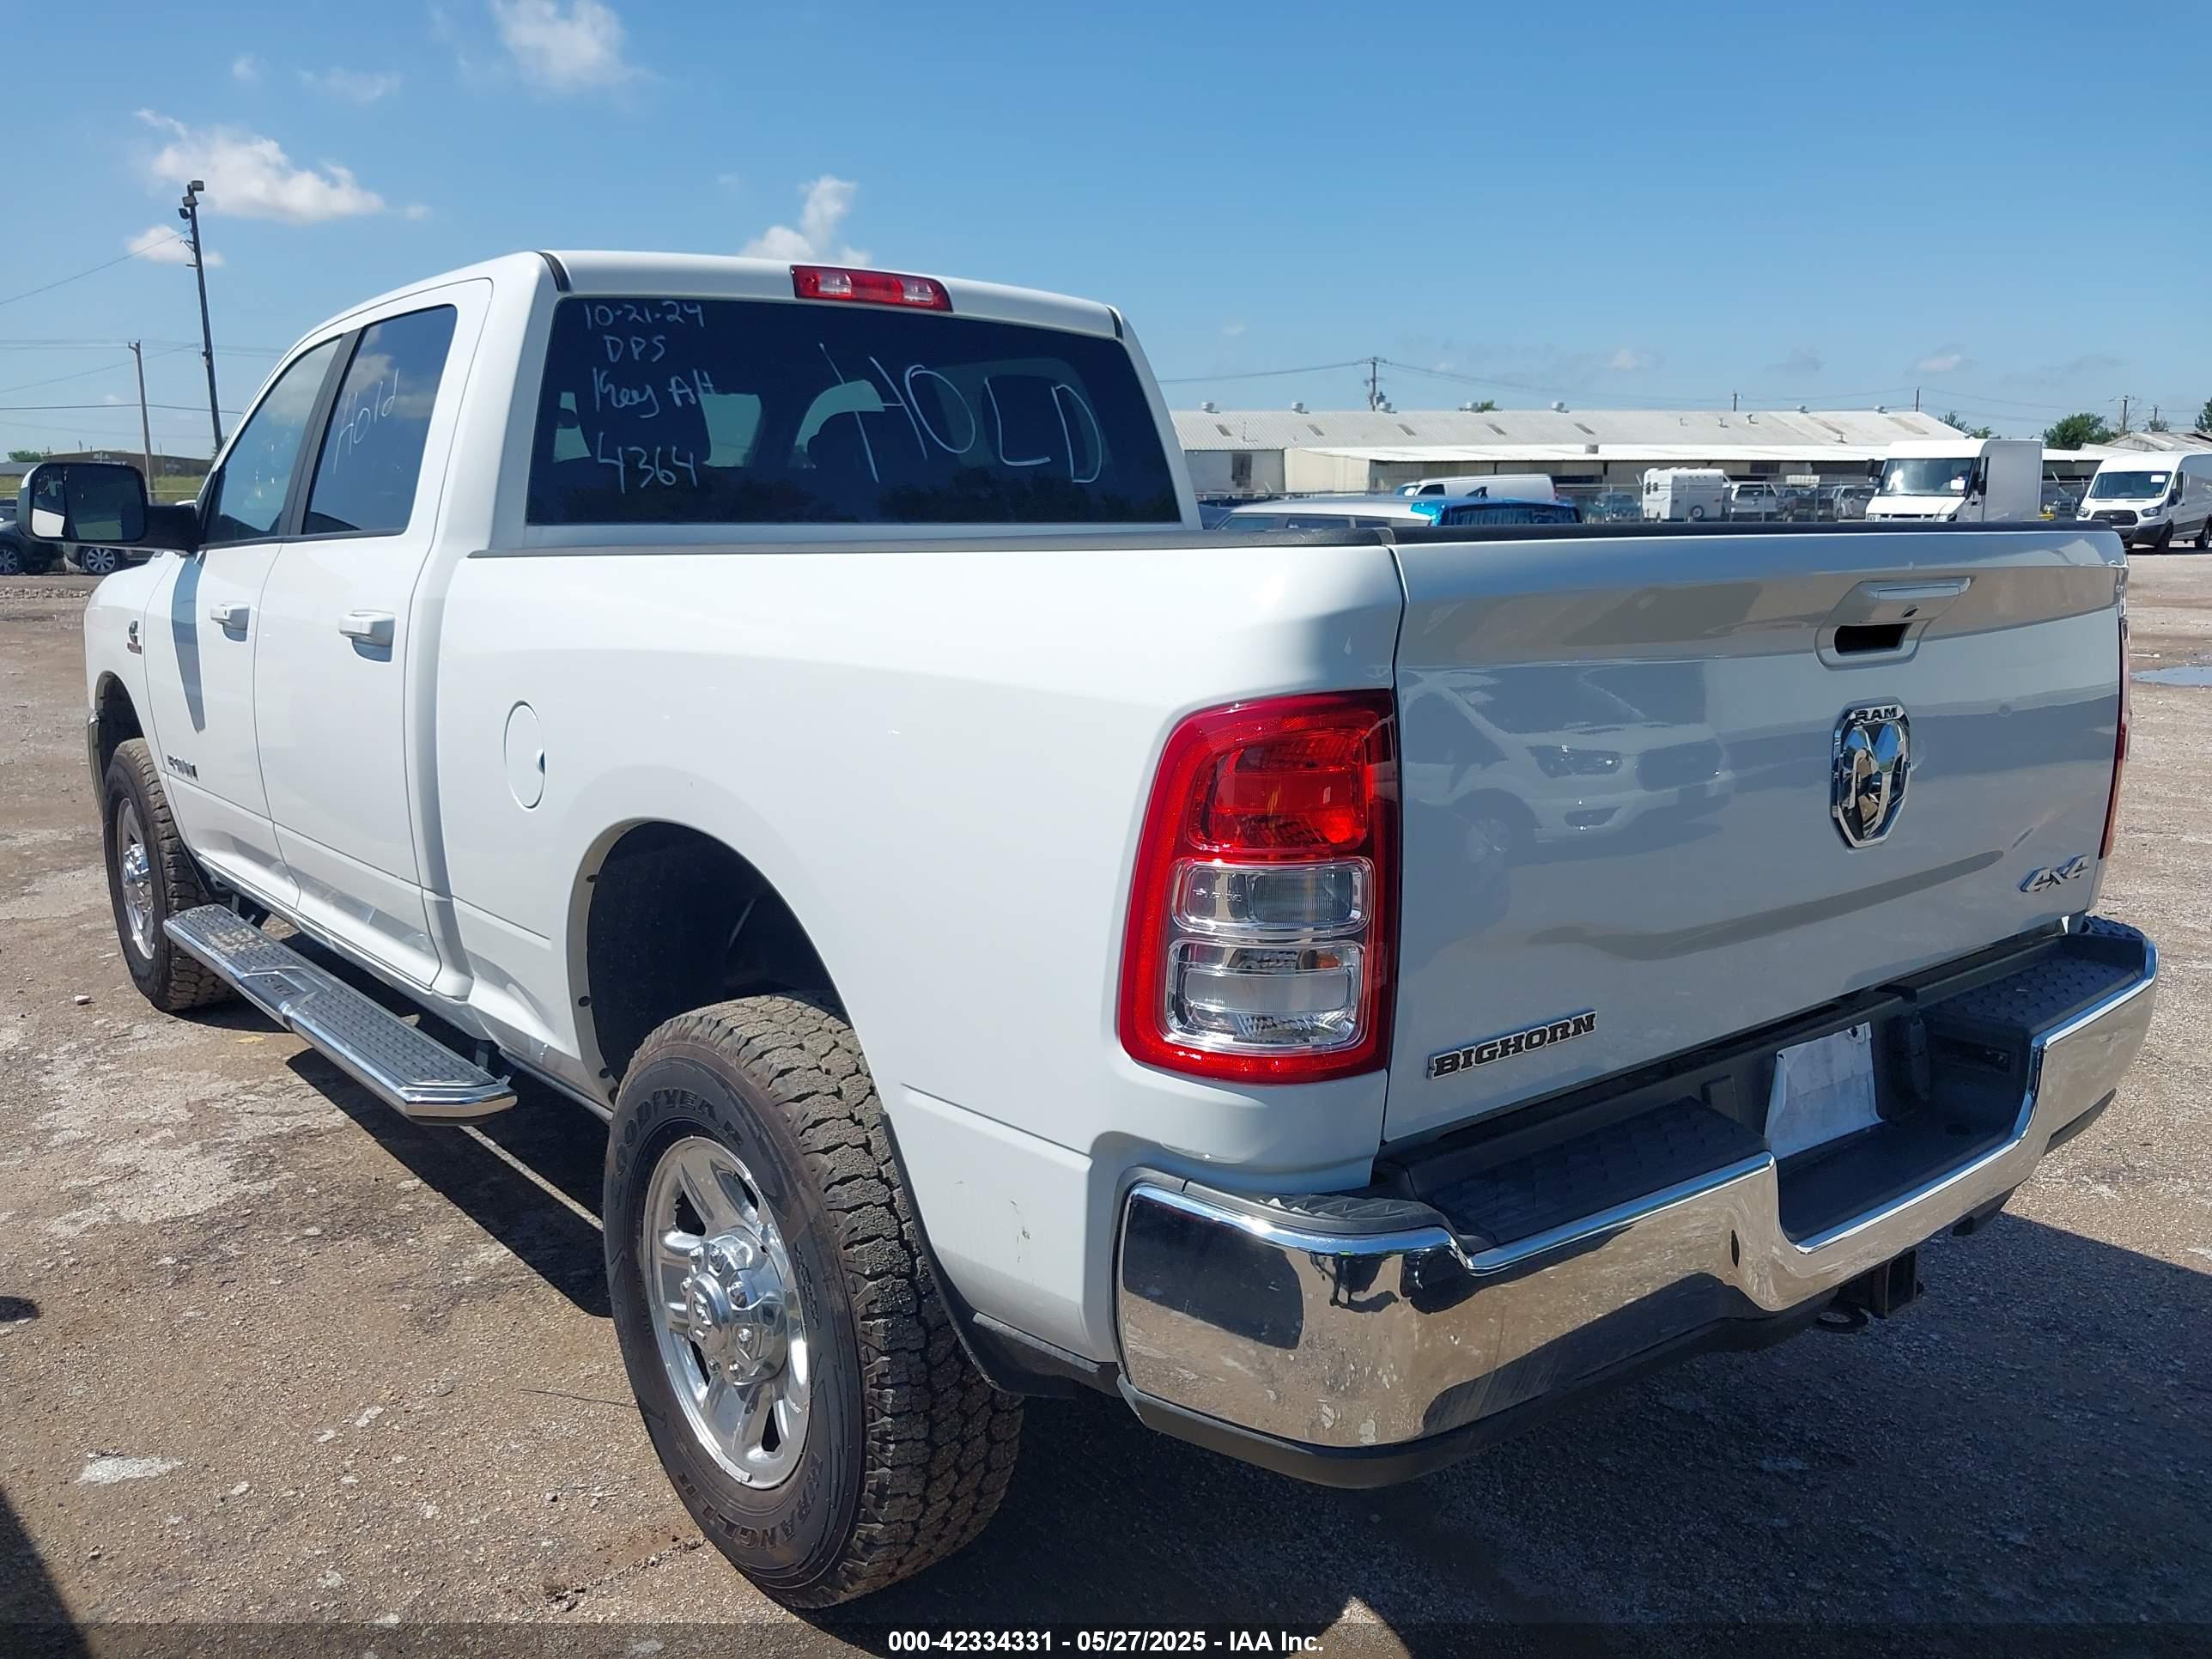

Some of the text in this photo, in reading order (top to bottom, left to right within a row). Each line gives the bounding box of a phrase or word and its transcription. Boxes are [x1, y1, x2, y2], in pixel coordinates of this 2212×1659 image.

[605, 335, 665, 362] DPS
[592, 367, 659, 419] Key
[818, 343, 1103, 484] HOLD
[598, 432, 698, 495] 4364
[1854, 707, 1898, 723] RAM
[1429, 1011, 1597, 1079] BIGHORN
